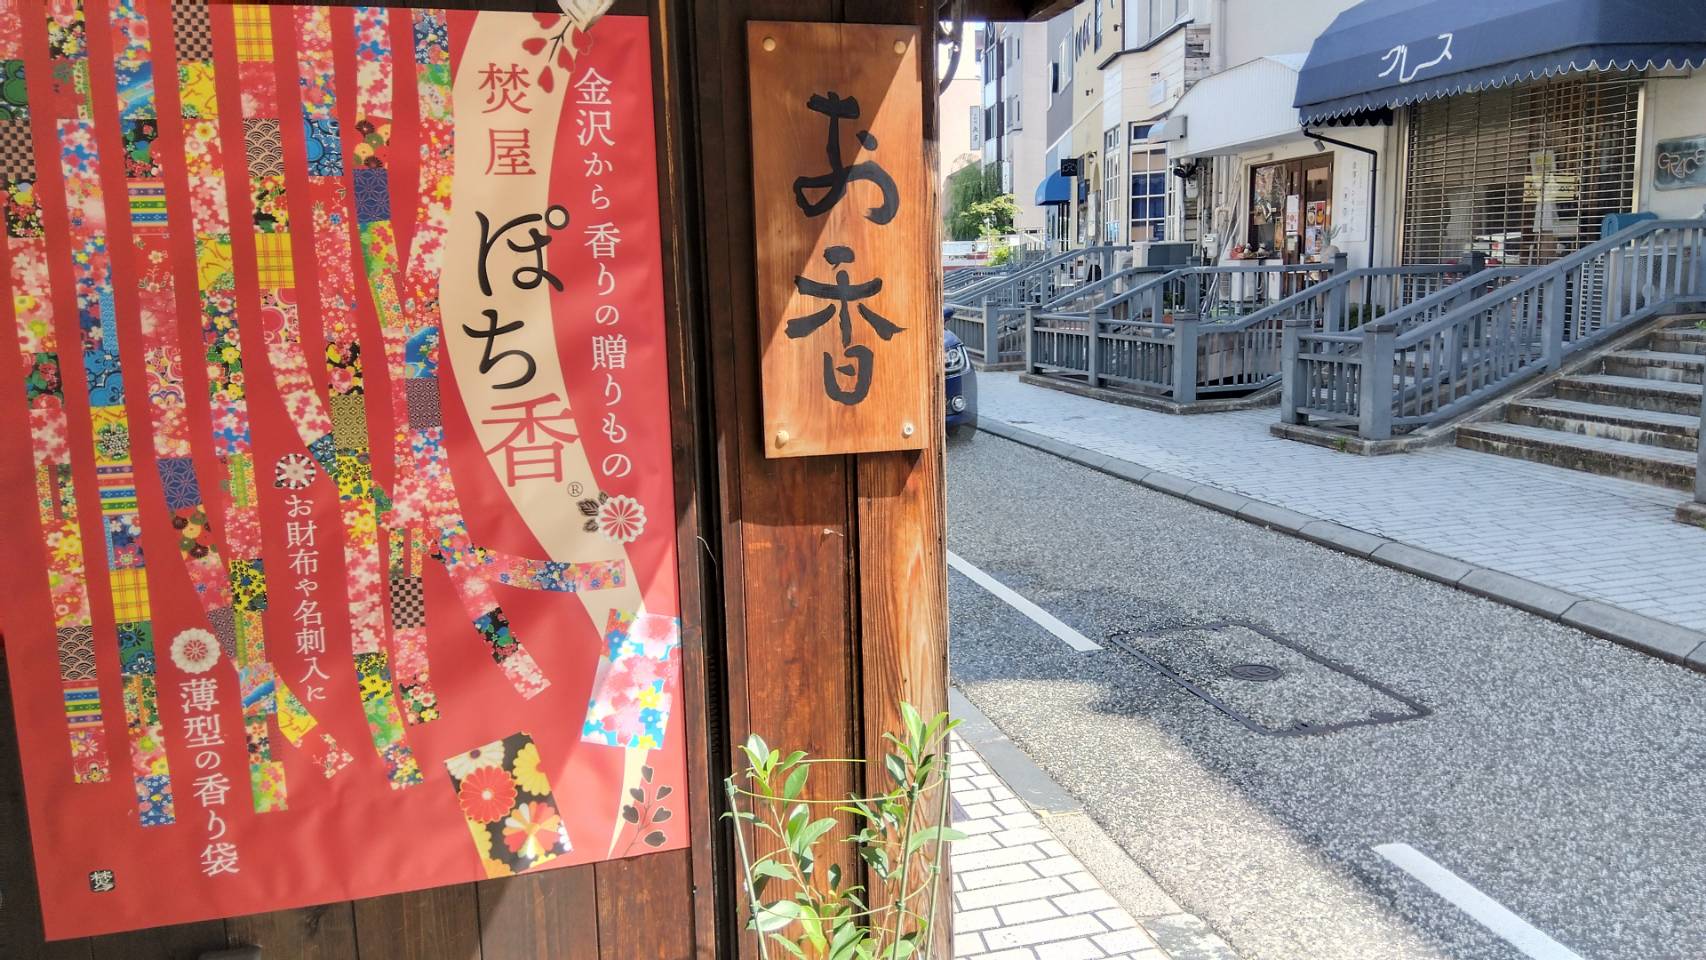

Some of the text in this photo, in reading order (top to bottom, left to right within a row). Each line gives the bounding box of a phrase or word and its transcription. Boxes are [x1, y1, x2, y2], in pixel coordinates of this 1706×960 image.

[573, 67, 633, 479] 金沢から香りの贈りもの
[784, 91, 909, 406] お香
[284, 495, 331, 703] お財布や名刺入に
[179, 678, 241, 878] 薄型の香り袋
